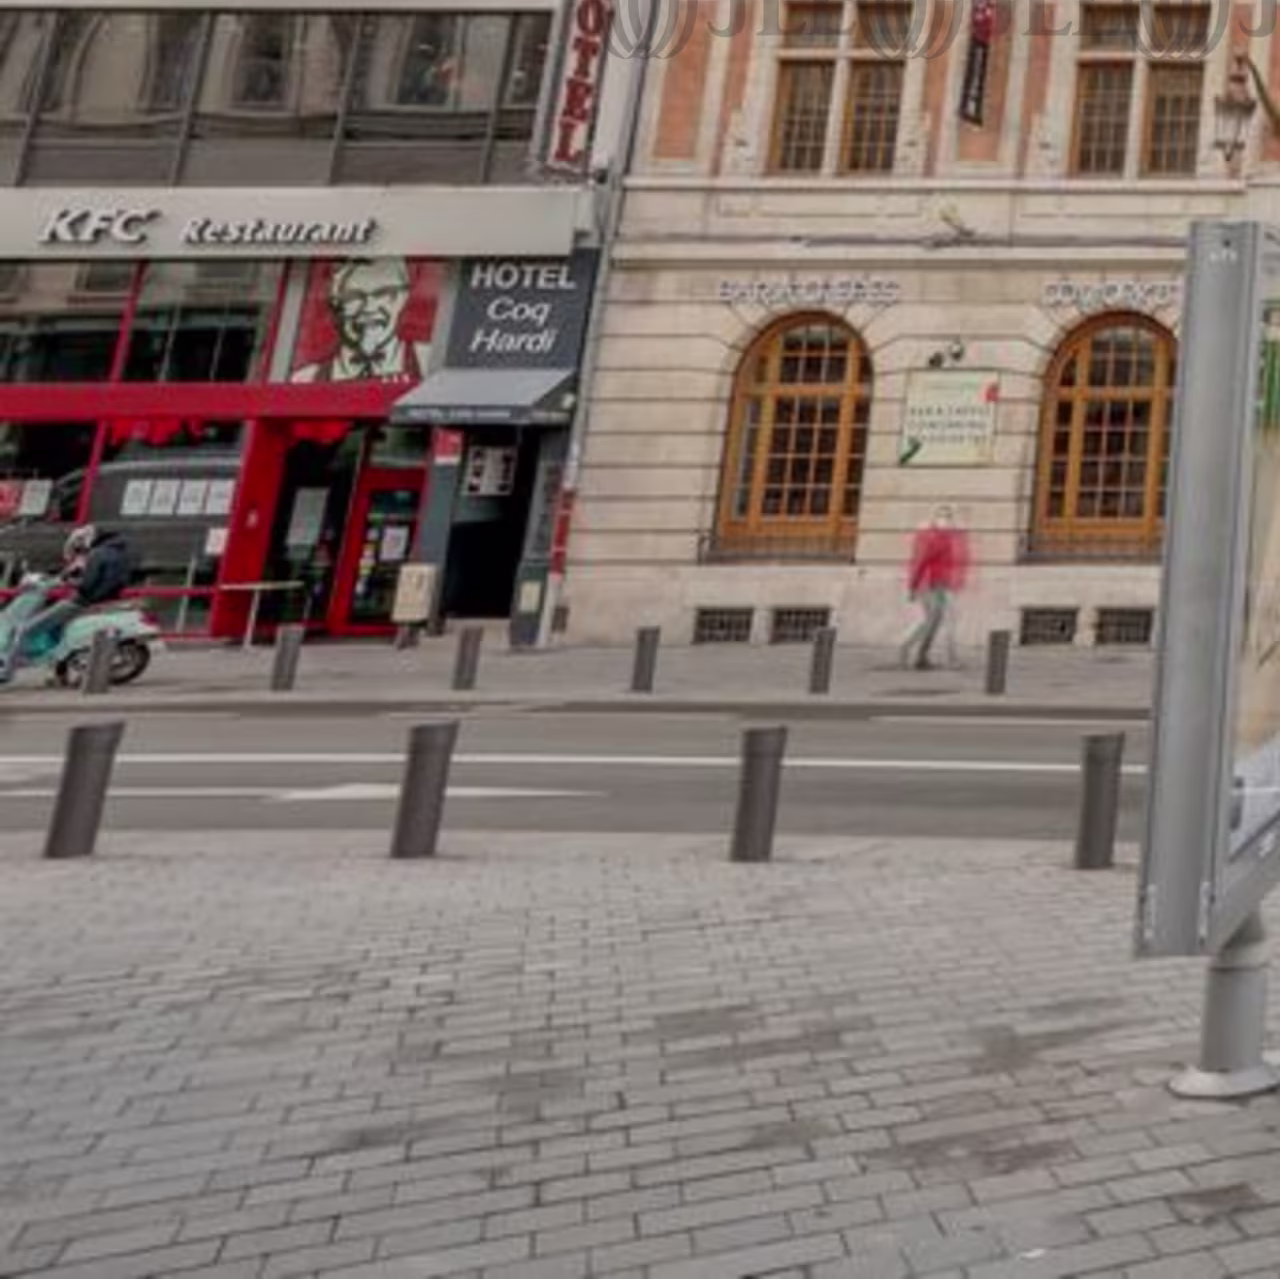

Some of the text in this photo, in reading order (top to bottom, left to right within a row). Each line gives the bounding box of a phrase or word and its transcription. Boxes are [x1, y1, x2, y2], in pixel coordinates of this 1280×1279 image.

[39, 209, 377, 245] KFC Restaurant
[470, 262, 577, 289] HOTEL
[486, 295, 552, 328] Coq
[469, 327, 560, 354] Hardi
